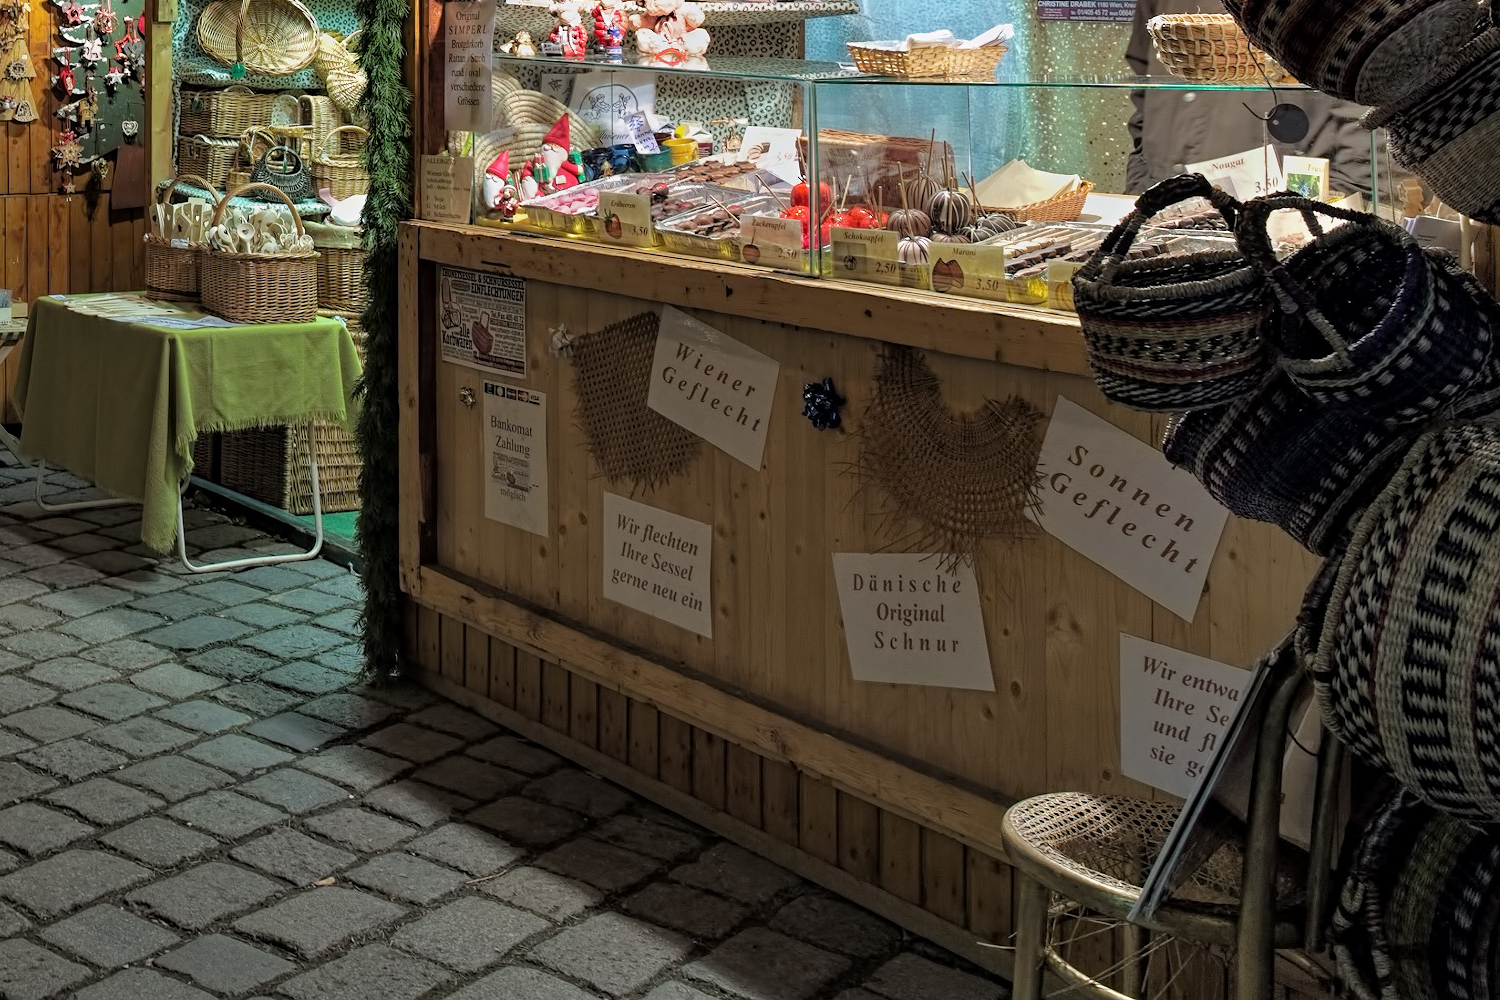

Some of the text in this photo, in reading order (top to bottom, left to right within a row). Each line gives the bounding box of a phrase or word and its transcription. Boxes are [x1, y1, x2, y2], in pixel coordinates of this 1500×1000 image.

[1038, 0, 1070, 8] CHRISTINE
[1070, 0, 1097, 8] DRABEK
[456, 10, 480, 22] Original
[448, 25, 487, 36] SIMPERL
[451, 69, 464, 77] rund
[469, 68, 481, 77] oval
[450, 83, 486, 92] verschiedene
[1211, 158, 1245, 171] Nougat
[610, 199, 636, 209] Erdbeeren
[631, 224, 649, 236] 3,50
[844, 231, 884, 243] Schokoapfel
[777, 248, 797, 260] 2,50
[952, 247, 977, 256] Maroni
[875, 262, 896, 275] 2,50
[442, 330, 473, 350] Korbwaren
[460, 323, 470, 338] alle
[675, 342, 756, 397] Wiener
[662, 366, 761, 432] Geflecht
[490, 415, 533, 437] Bankomat
[495, 435, 531, 459] Zahlung
[500, 487, 526, 502] möglich
[1067, 445, 1195, 533] Sonnen
[1050, 472, 1199, 574] Geflecht
[617, 513, 699, 557] Wir flechten
[620, 541, 694, 582] Ihre Sessel
[611, 568, 703, 612] gerne neu ein
[852, 573, 961, 594] Dänische
[876, 602, 945, 627] Original
[874, 630, 959, 653] Schnur
[1142, 655, 1177, 682] Wir
[1153, 687, 1195, 716] Ihre
[1153, 719, 1192, 743] und
[1149, 745, 1176, 766] sie
